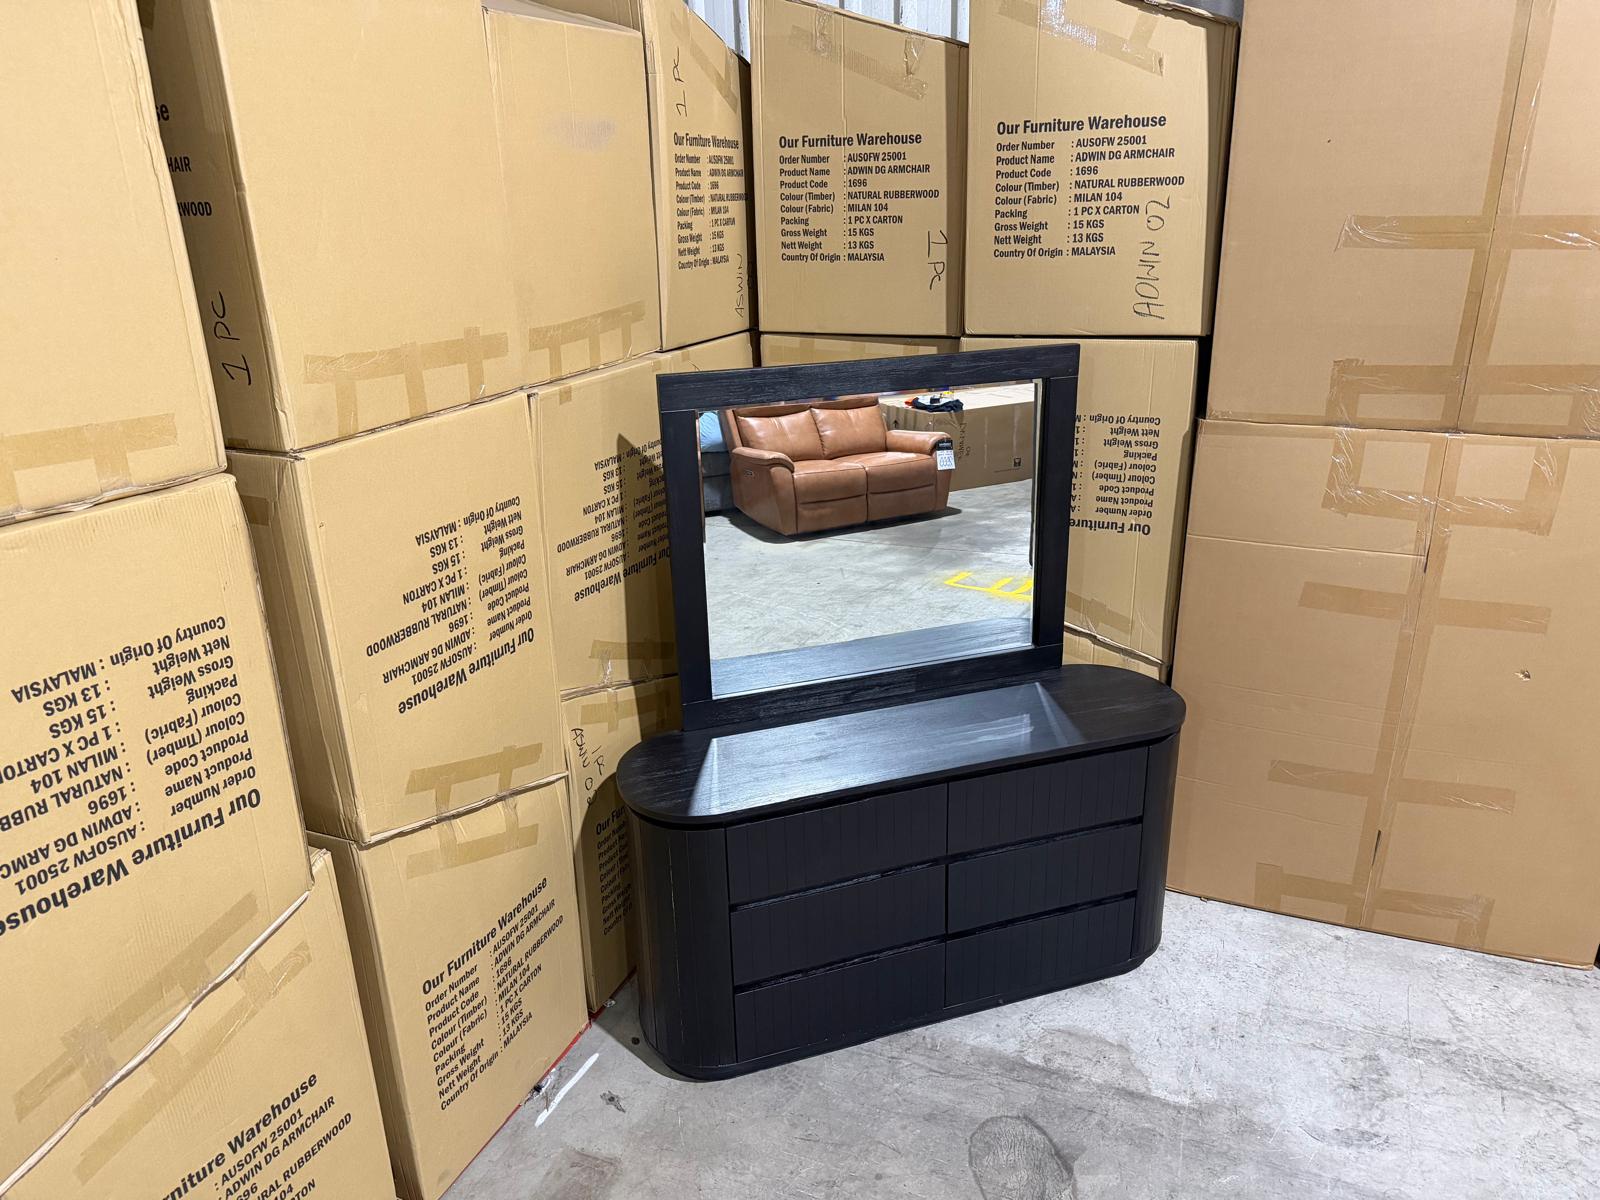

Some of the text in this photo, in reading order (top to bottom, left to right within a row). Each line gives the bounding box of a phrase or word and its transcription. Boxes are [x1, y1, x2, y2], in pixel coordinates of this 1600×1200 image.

[997, 114, 1167, 135] Our Furniture Warehouse
[673, 132, 739, 150] Our Furniture Warehouse
[779, 132, 922, 149] Our Furniture Warehouse
[996, 135, 1147, 152] Order Number AUSOFW 25001
[779, 151, 907, 165] Order Number AUSOFW 25001
[996, 148, 1175, 166] Product Name ADWIN DG ARMCHAIR
[779, 164, 930, 177] Product Name ADWIN DG ARMCHAIR
[996, 165, 1099, 179] Product Code 1696
[779, 178, 867, 189] Product Code 1696
[995, 176, 1185, 193] Colour (Timber) NATURAL RUBBERWOOD
[780, 189, 940, 203] Colour (Timber) NATURAL RUBBERWOOD
[995, 191, 1123, 206] Colour (Fabric) MILAN 104
[780, 203, 889, 215] Colour (Fabric) MILAN 104
[994, 204, 1140, 220] Packing 1 PC X CARTON
[994, 219, 1104, 233] Gross Weight 15 KGS
[928, 230, 948, 258] 1
[994, 232, 1104, 246] Nett Weight 13 KGS
[781, 252, 885, 263] Country Of Origin MALAYSIA
[993, 246, 1116, 259] Country Of Origin MALAYSIA
[1133, 195, 1170, 320] ADWIN 02
[210, 291, 252, 387] 1 PC
[1089, 413, 1161, 426] Country Of Origin
[1099, 485, 1155, 496] Product Code
[415, 496, 520, 546] Country Of Origin MALAYSIA
[1095, 506, 1152, 519] Order Number
[1127, 523, 1151, 536] Our
[574, 552, 657, 602] Furniture Warehouse
[366, 568, 528, 657] Colour (Timber) NATURAL RUBBERWOOD
[382, 596, 531, 684] Product Name ADWIN DG ARMCHAIR
[411, 610, 533, 685] Order Number AUSOFW 25001
[10, 616, 226, 703] Country Of Origin MALAYSIA
[398, 627, 535, 714] Our Furniture Warehouse
[43, 634, 230, 717] Nett Weight 13 KGS
[30, 693, 241, 794] Colour (Fabric) MILAN 104
[87, 729, 249, 815] Product Code 1696
[228, 788, 261, 816] Our
[14, 766, 256, 895] Order Number AUSOFW 25001
[131, 807, 225, 865] Furniture
[422, 877, 547, 995] Our Furniture Warehouse
[425, 903, 538, 1012] Order Number AUSOFW 25001
[227, 1074, 317, 1155] Warehouse
[282, 1096, 335, 1151] ARMCHAIR
[221, 1108, 304, 1186] AUSOFW 25001
[282, 1113, 351, 1182] RUBBERWOOD
